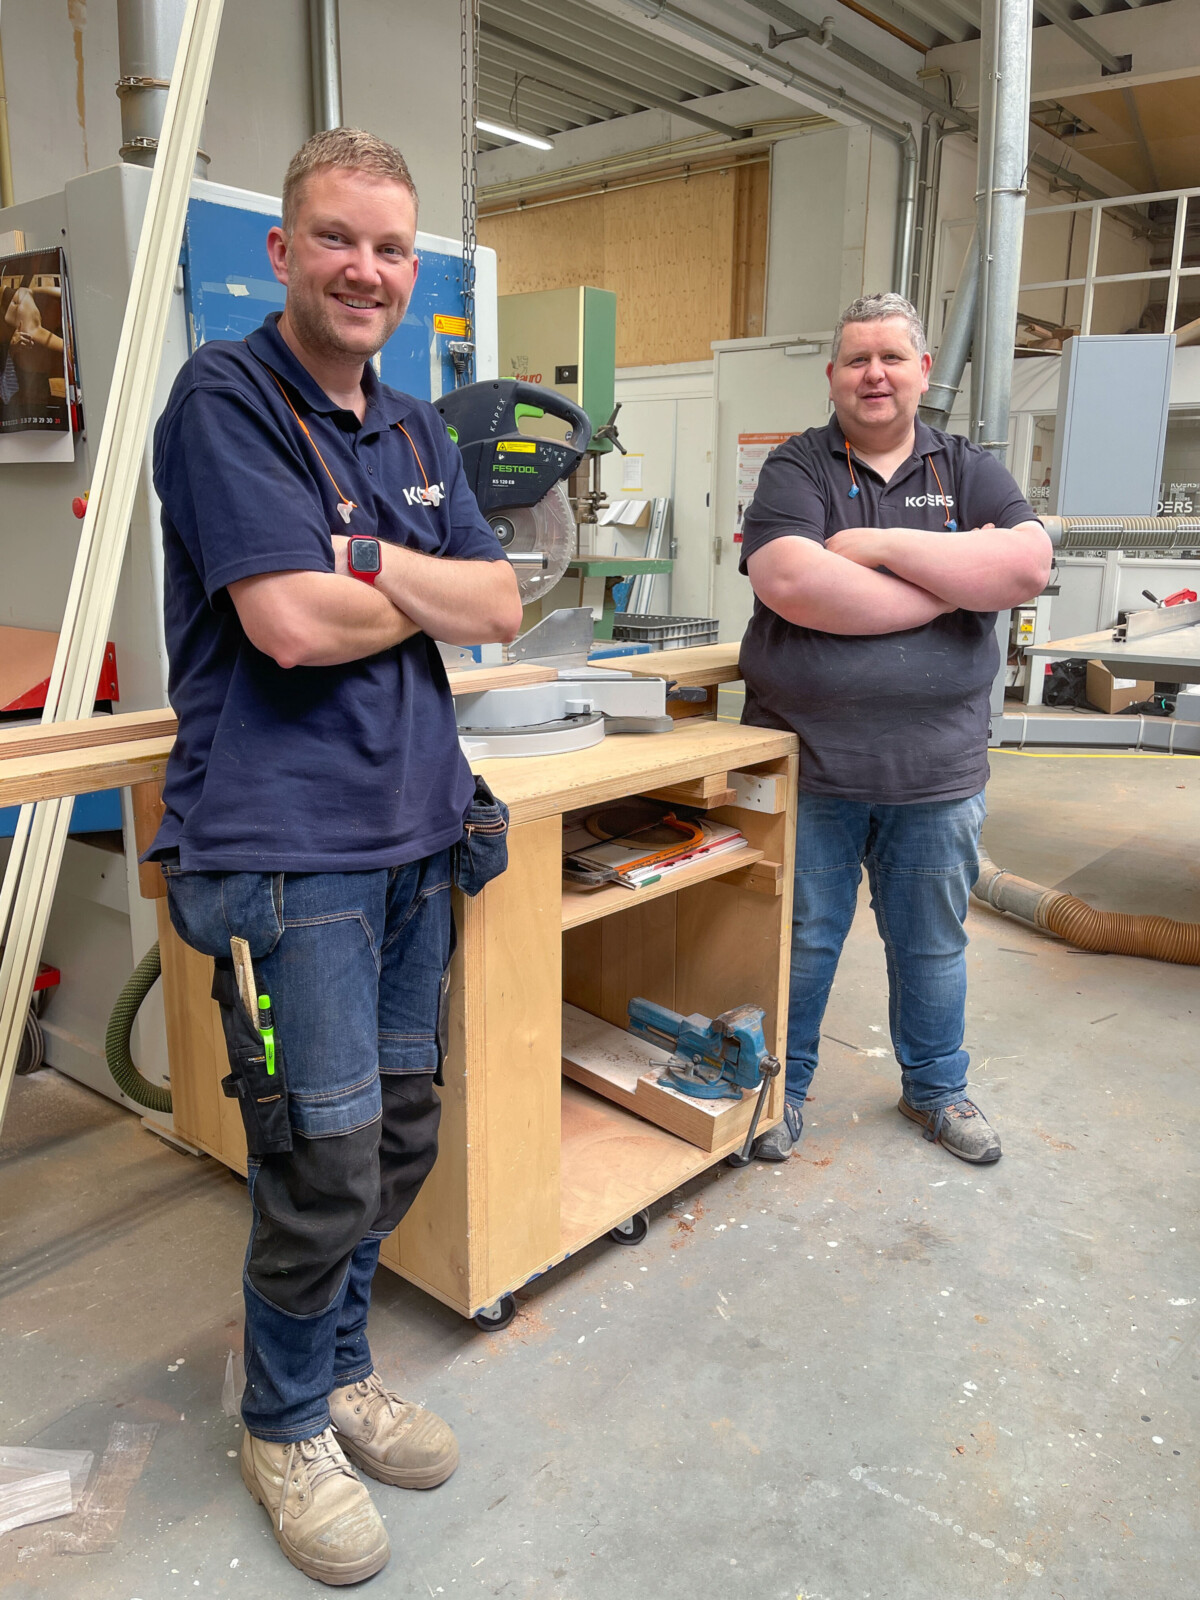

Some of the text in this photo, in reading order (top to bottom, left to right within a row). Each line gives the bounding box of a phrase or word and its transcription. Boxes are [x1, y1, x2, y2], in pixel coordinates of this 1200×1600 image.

[515, 373, 542, 383] tauro
[489, 398, 506, 432] KAPEX
[492, 464, 538, 474] FESTOOL
[905, 493, 954, 507] KOERS
[1156, 501, 1193, 514] OERS
